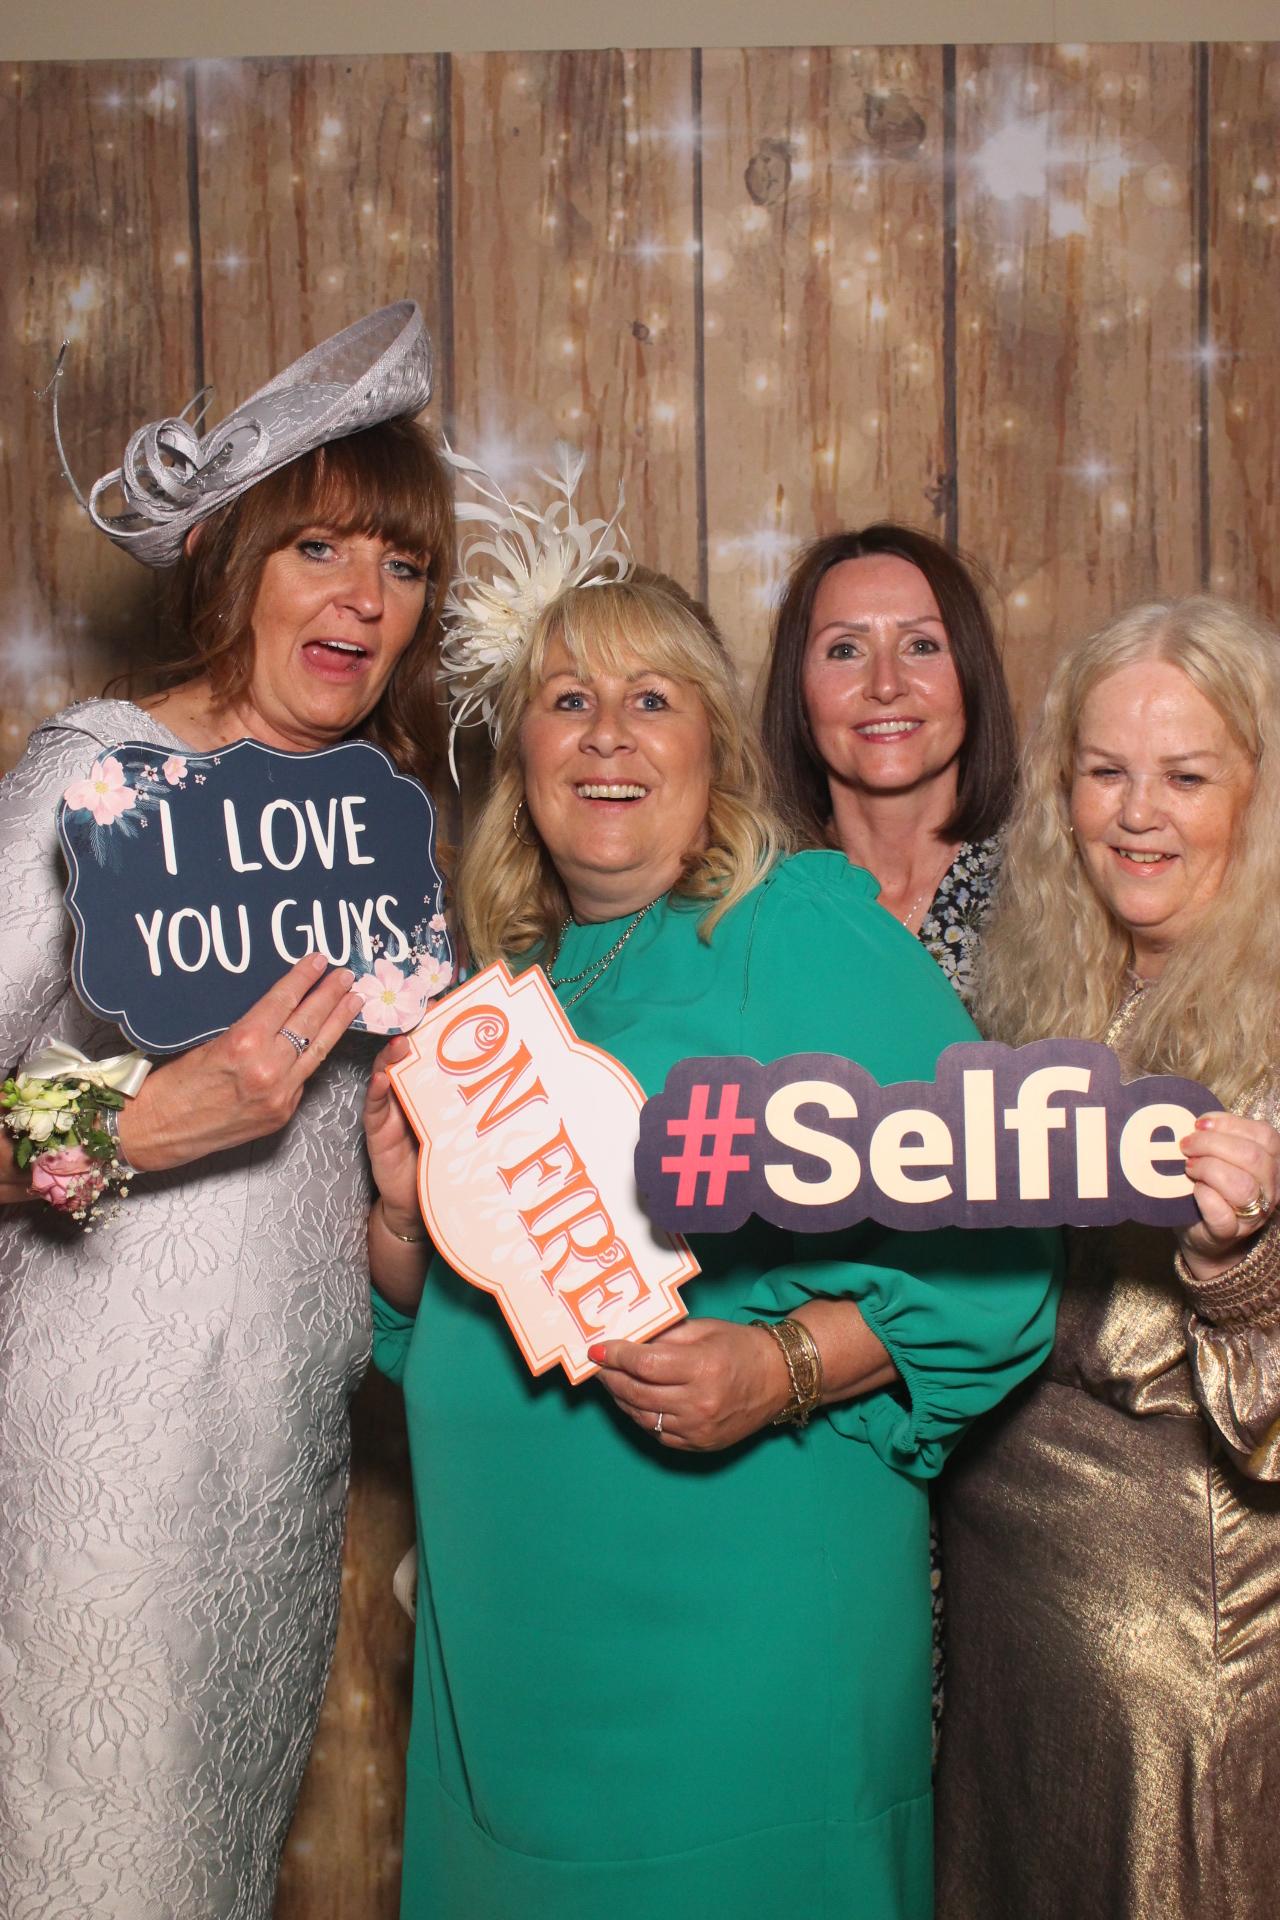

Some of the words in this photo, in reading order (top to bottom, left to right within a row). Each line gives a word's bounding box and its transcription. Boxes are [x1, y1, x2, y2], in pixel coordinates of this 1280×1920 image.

[159, 799, 178, 875] I
[224, 796, 375, 872] LOVE
[135, 904, 251, 977] YOU
[271, 894, 409, 967] GUYS
[435, 1004, 549, 1138] ON
[496, 1117, 652, 1343] FIRE
[660, 1065, 1197, 1206] #Selfie
